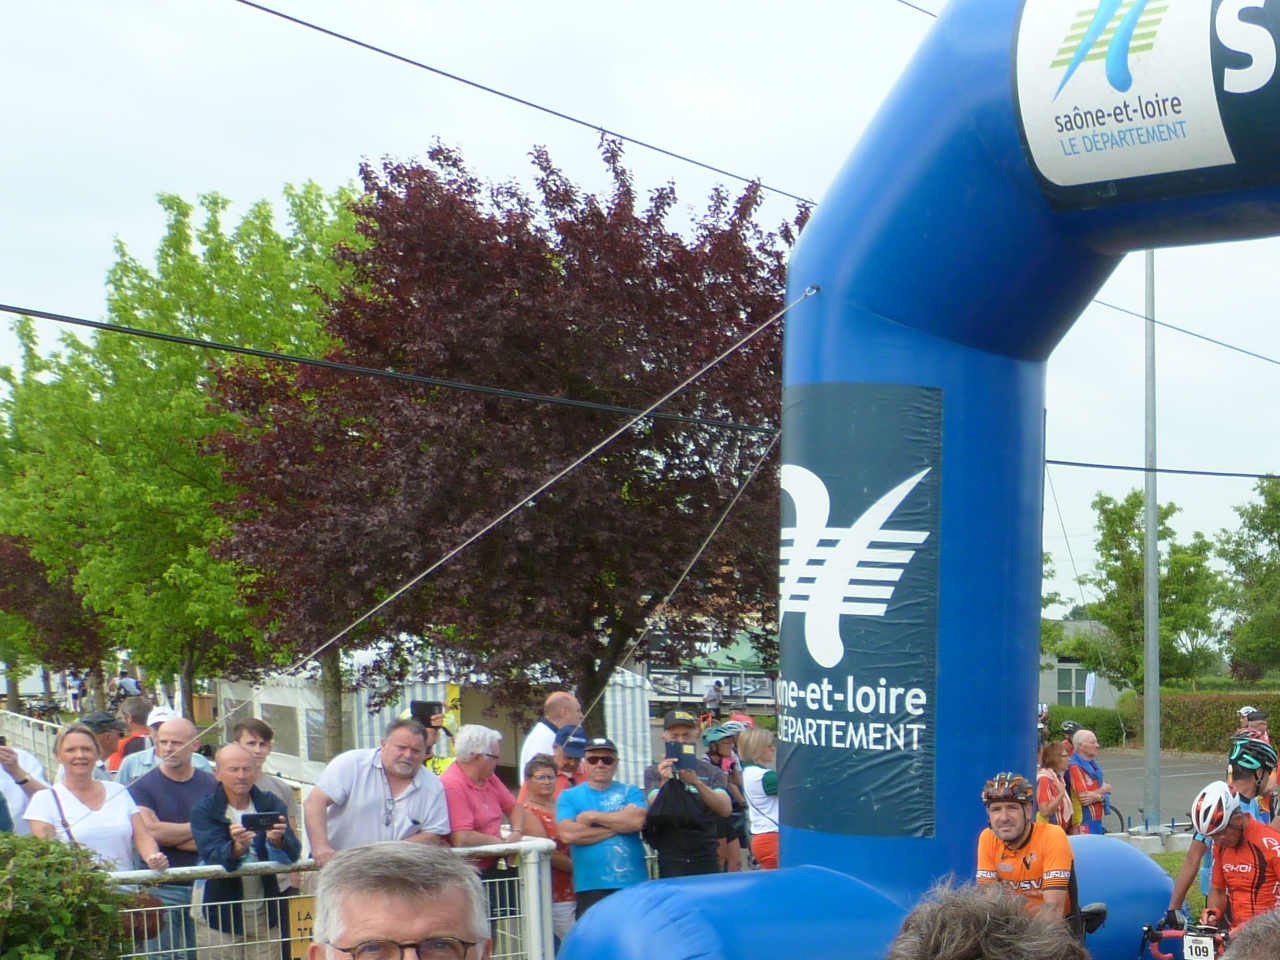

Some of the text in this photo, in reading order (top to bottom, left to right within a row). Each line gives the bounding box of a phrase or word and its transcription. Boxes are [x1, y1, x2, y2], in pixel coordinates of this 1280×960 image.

[1054, 93, 1183, 133] saône-et-loire
[1060, 121, 1187, 156] LE DÉPARTEMENT
[1188, 944, 1209, 957] 109
